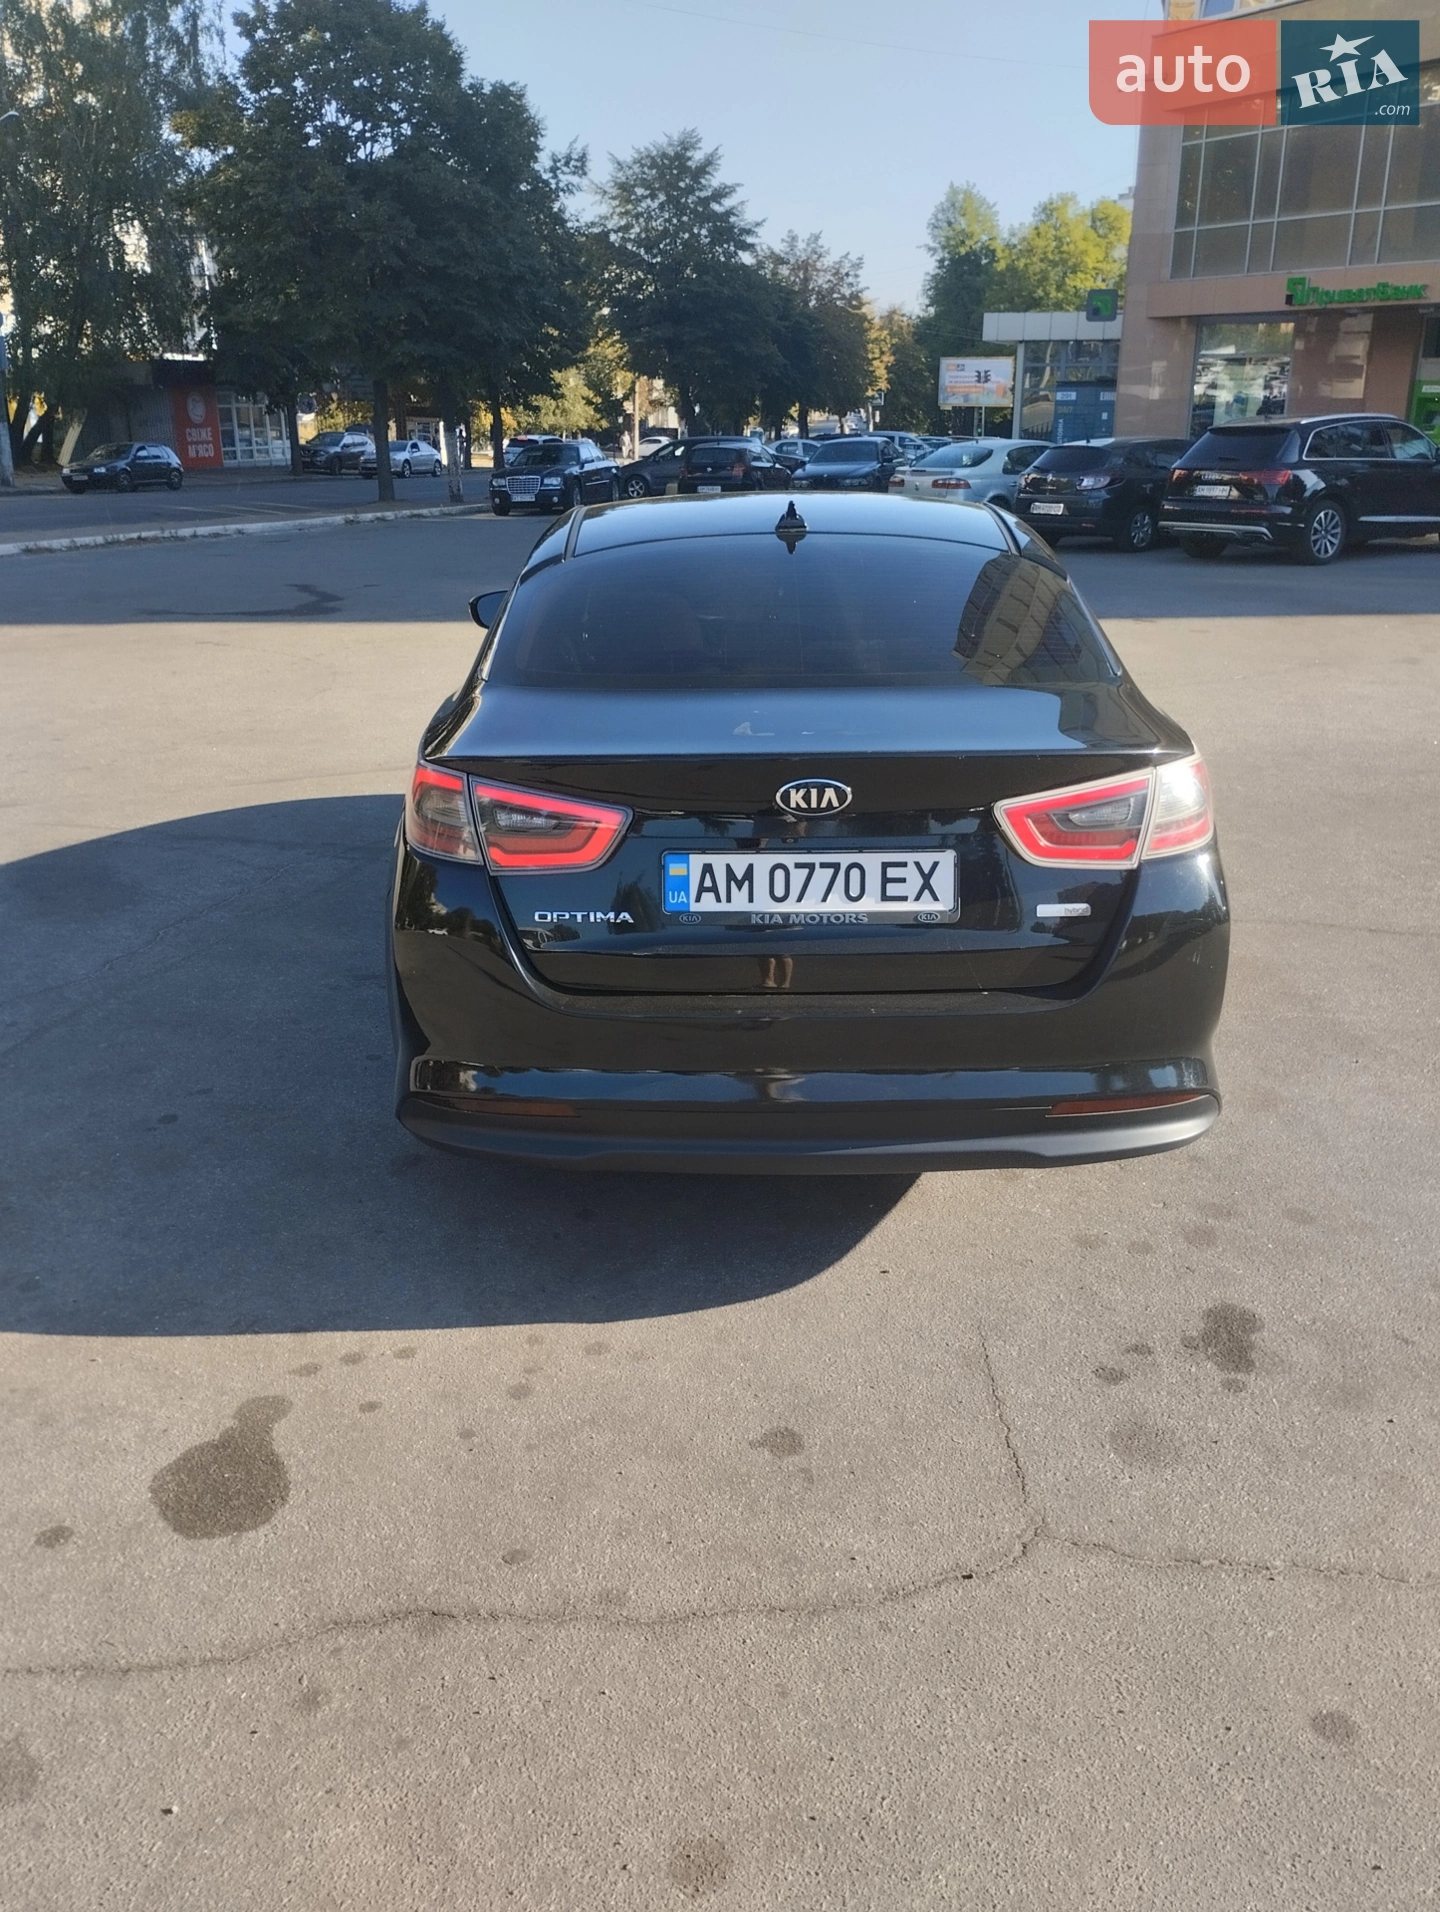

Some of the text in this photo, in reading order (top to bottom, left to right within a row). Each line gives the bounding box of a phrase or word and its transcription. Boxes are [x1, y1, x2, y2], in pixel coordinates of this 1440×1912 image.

[1307, 281, 1428, 308] ПриватБанк
[186, 427, 213, 442] СВІЖЕ
[188, 443, 215, 458] М'ЯСО
[788, 787, 840, 808] KIA
[694, 860, 940, 903] AM 0770 EX
[668, 890, 688, 903] UA
[534, 911, 635, 923] OPTIMA
[682, 914, 698, 922] KIA
[750, 912, 868, 924] KIA MOTORS
[920, 912, 937, 922] KIA
